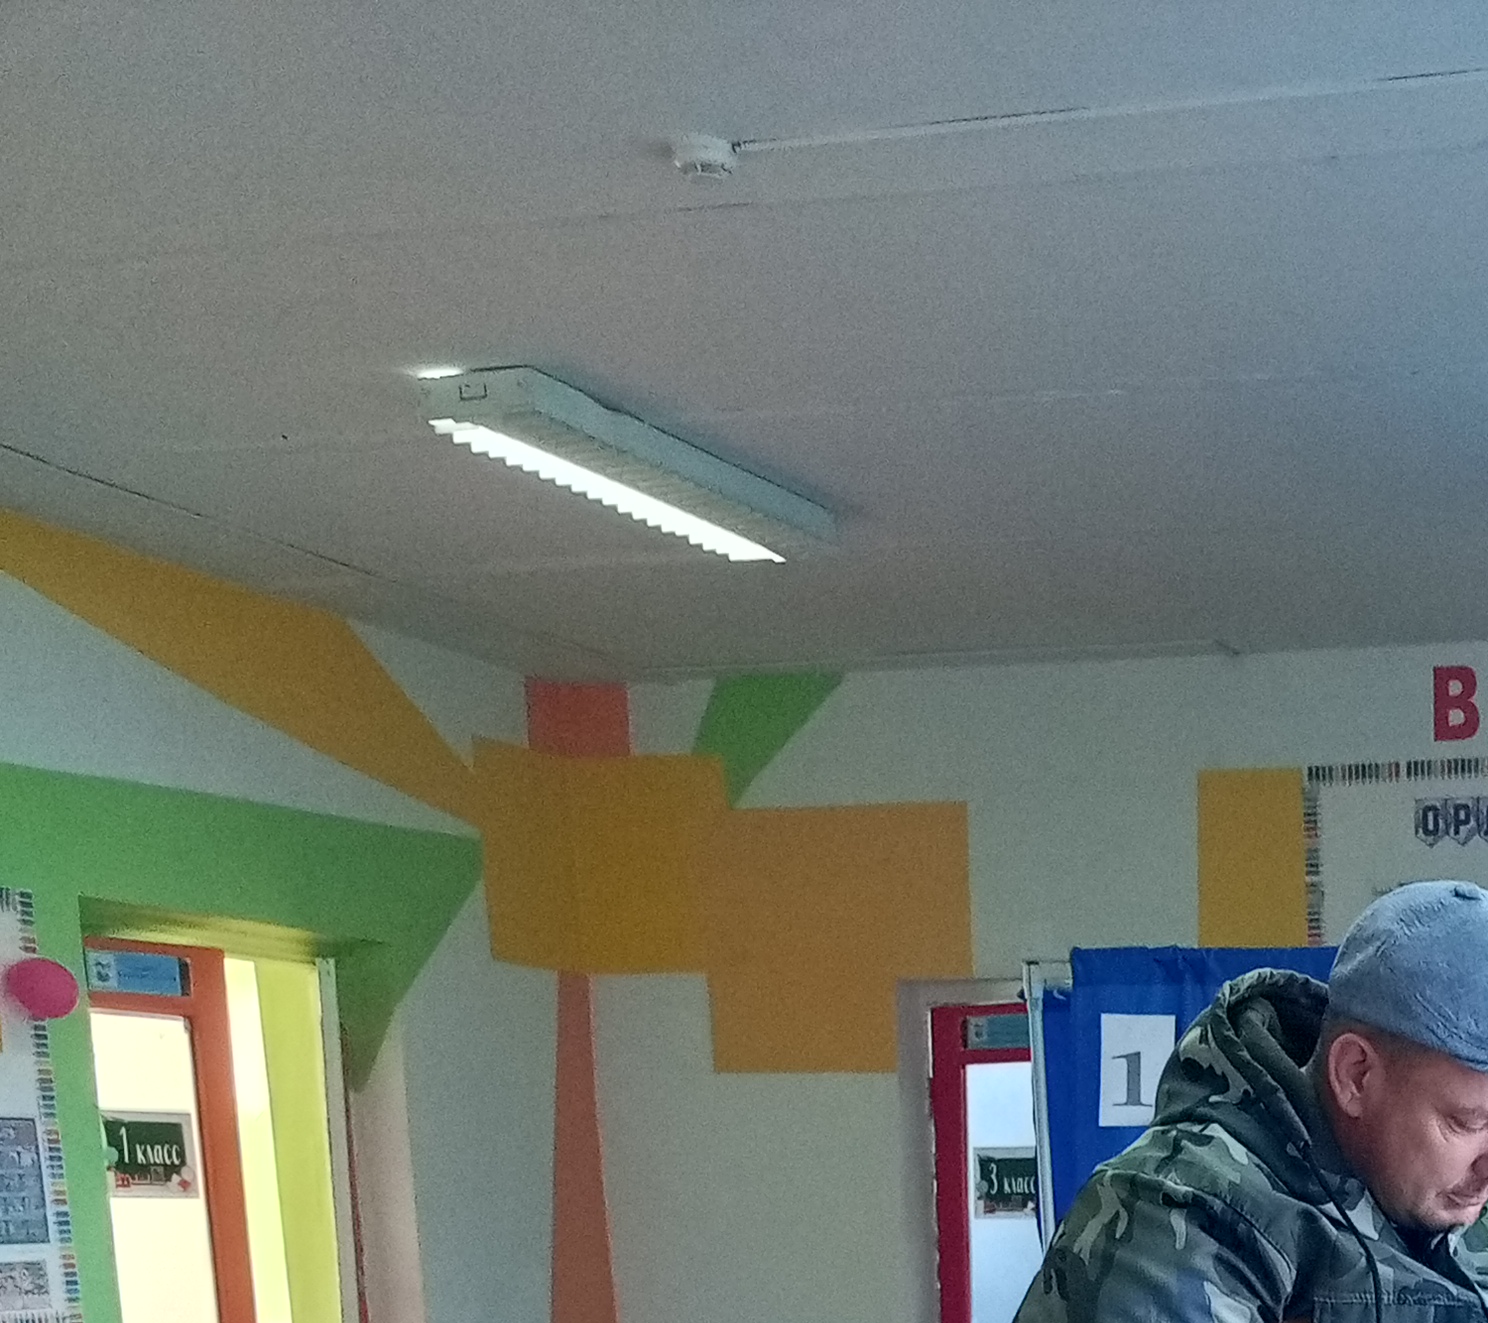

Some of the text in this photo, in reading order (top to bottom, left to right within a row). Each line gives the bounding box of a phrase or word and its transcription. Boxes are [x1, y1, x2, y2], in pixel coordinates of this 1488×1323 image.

[1111, 1050, 1153, 1107] 1
[119, 1126, 181, 1165] 1 класс
[988, 1162, 998, 1195] 3
